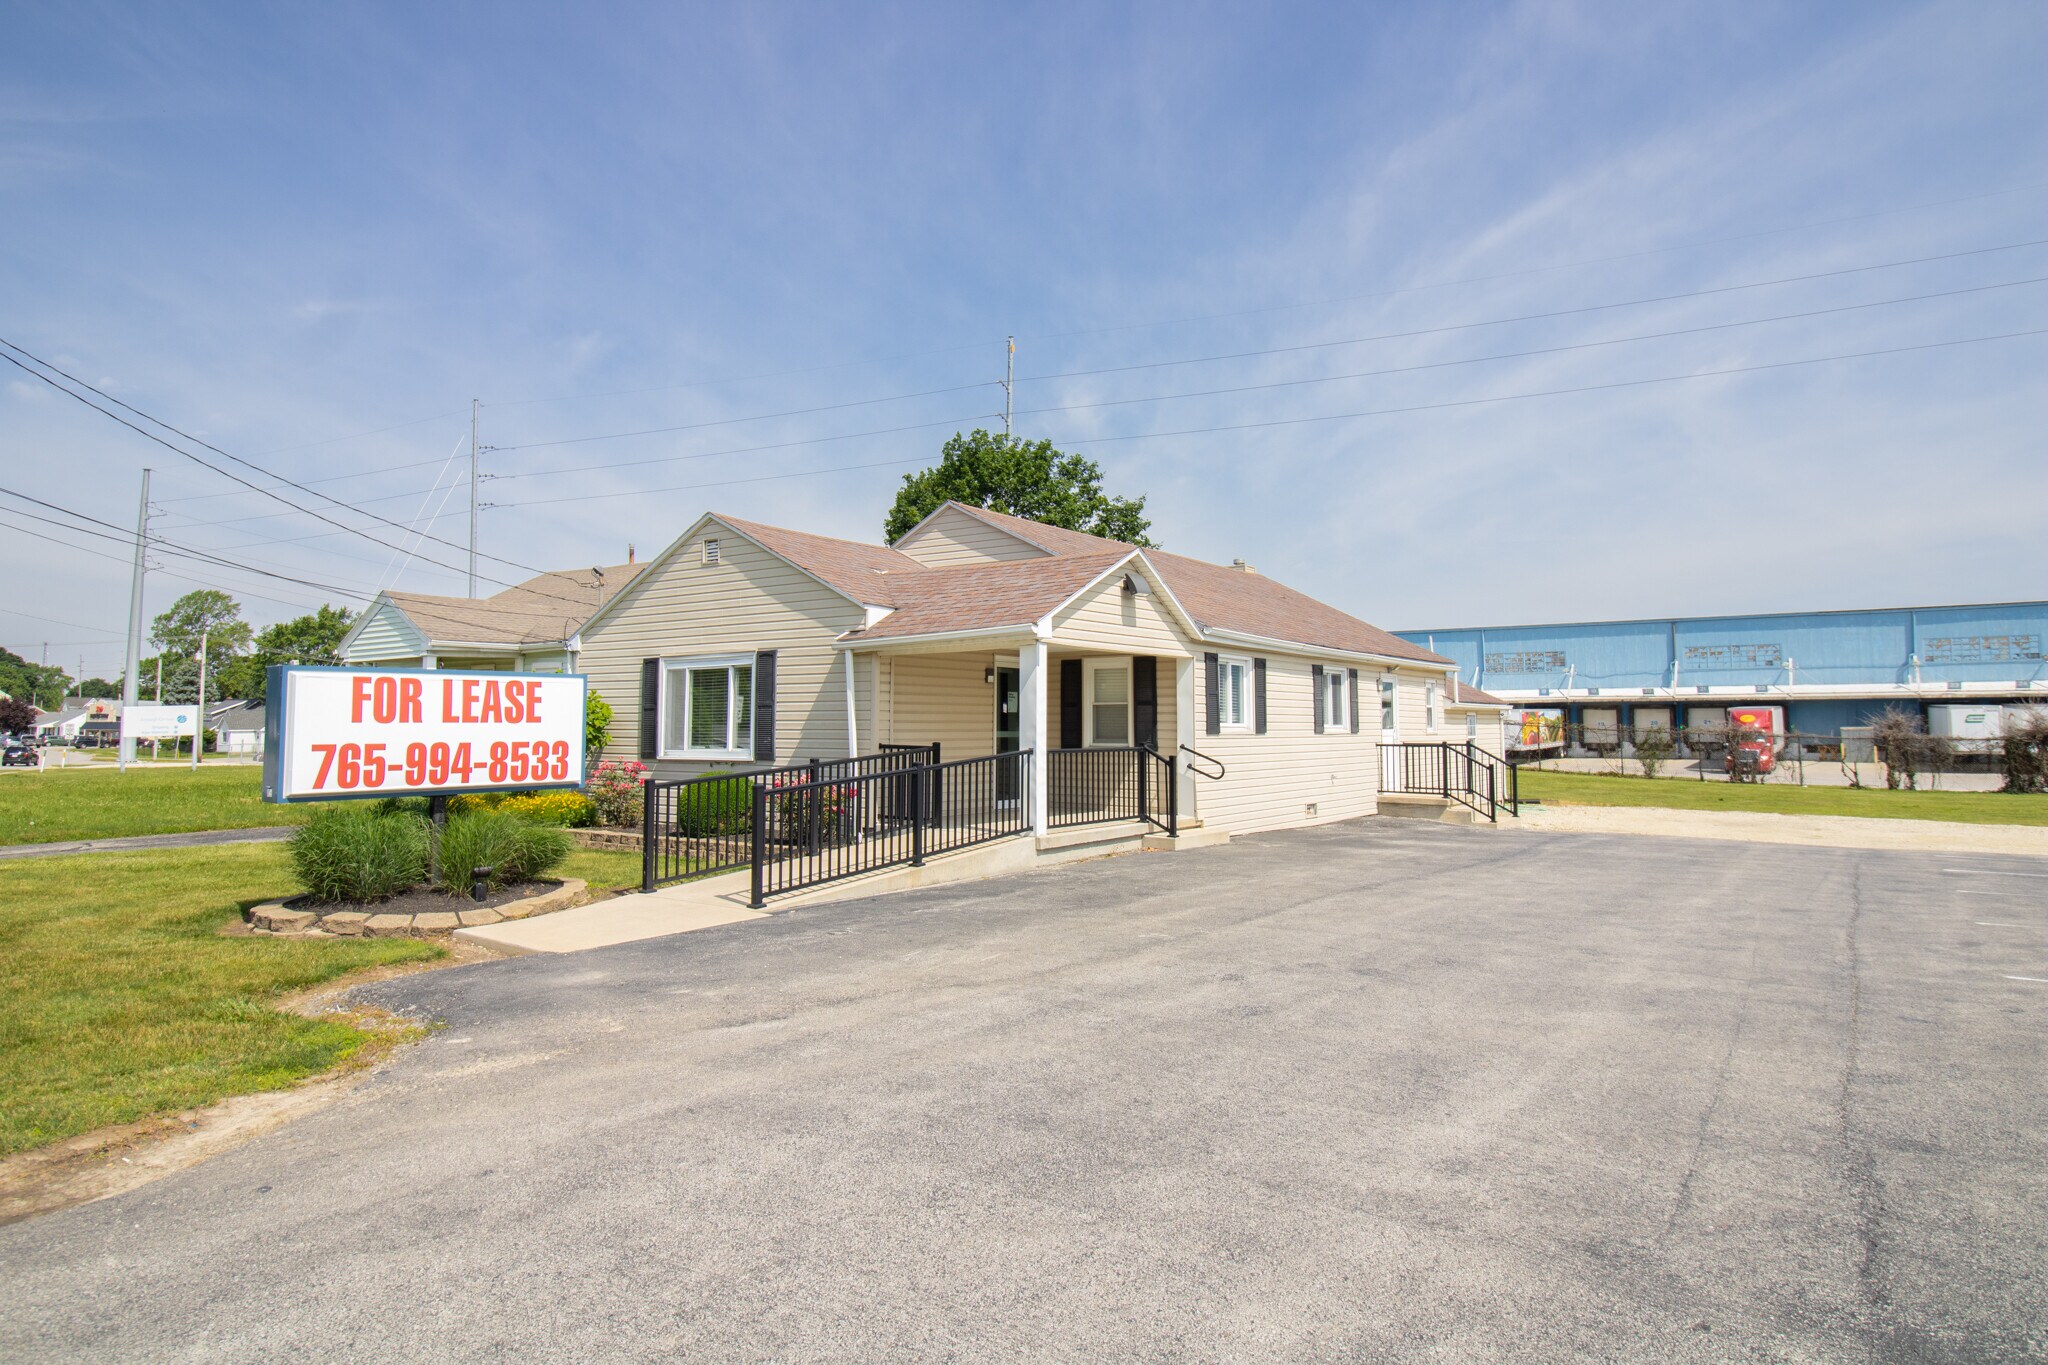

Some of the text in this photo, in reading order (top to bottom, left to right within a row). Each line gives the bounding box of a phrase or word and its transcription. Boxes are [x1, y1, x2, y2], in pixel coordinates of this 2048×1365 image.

[352, 677, 542, 723] FOR LEASE
[312, 741, 568, 789] 765-994-8533
